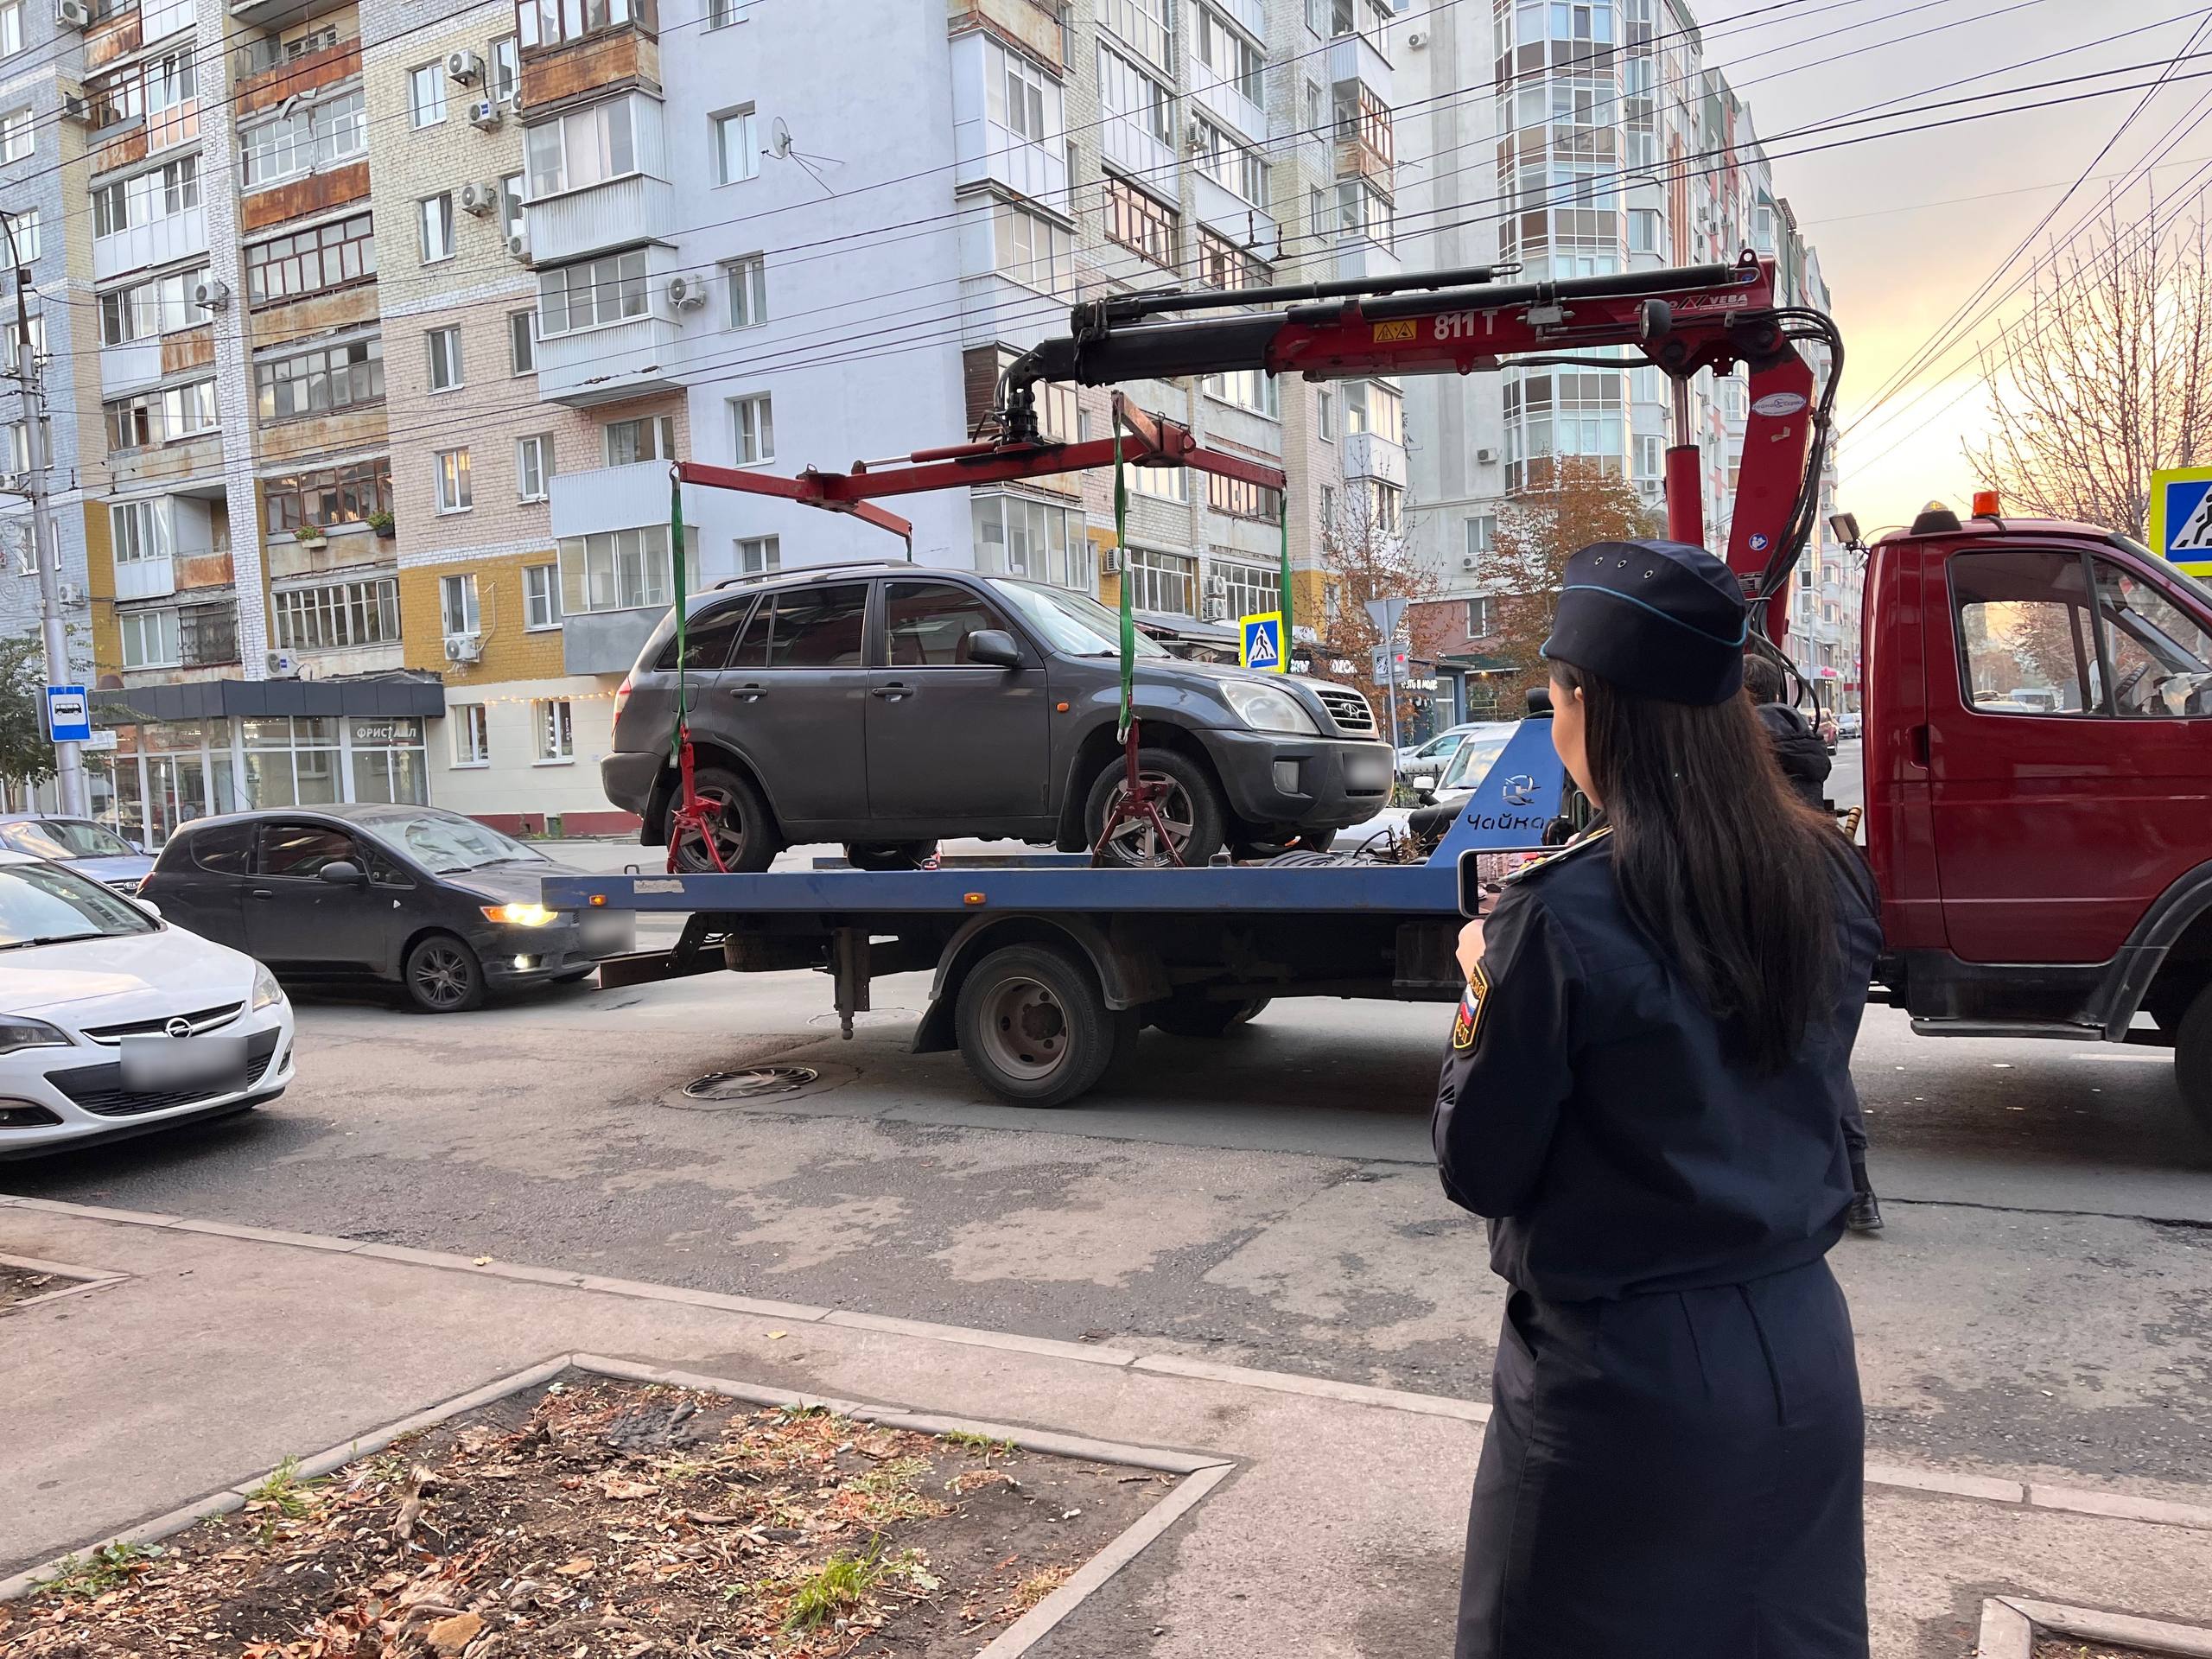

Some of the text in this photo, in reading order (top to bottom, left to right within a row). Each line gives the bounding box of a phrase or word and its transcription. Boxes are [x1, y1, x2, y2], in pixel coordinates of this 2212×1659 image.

[1434, 310, 1498, 340] 811 T
[357, 727, 416, 739] ФРИСТАЛ
[1467, 813, 1545, 830] Чайка
